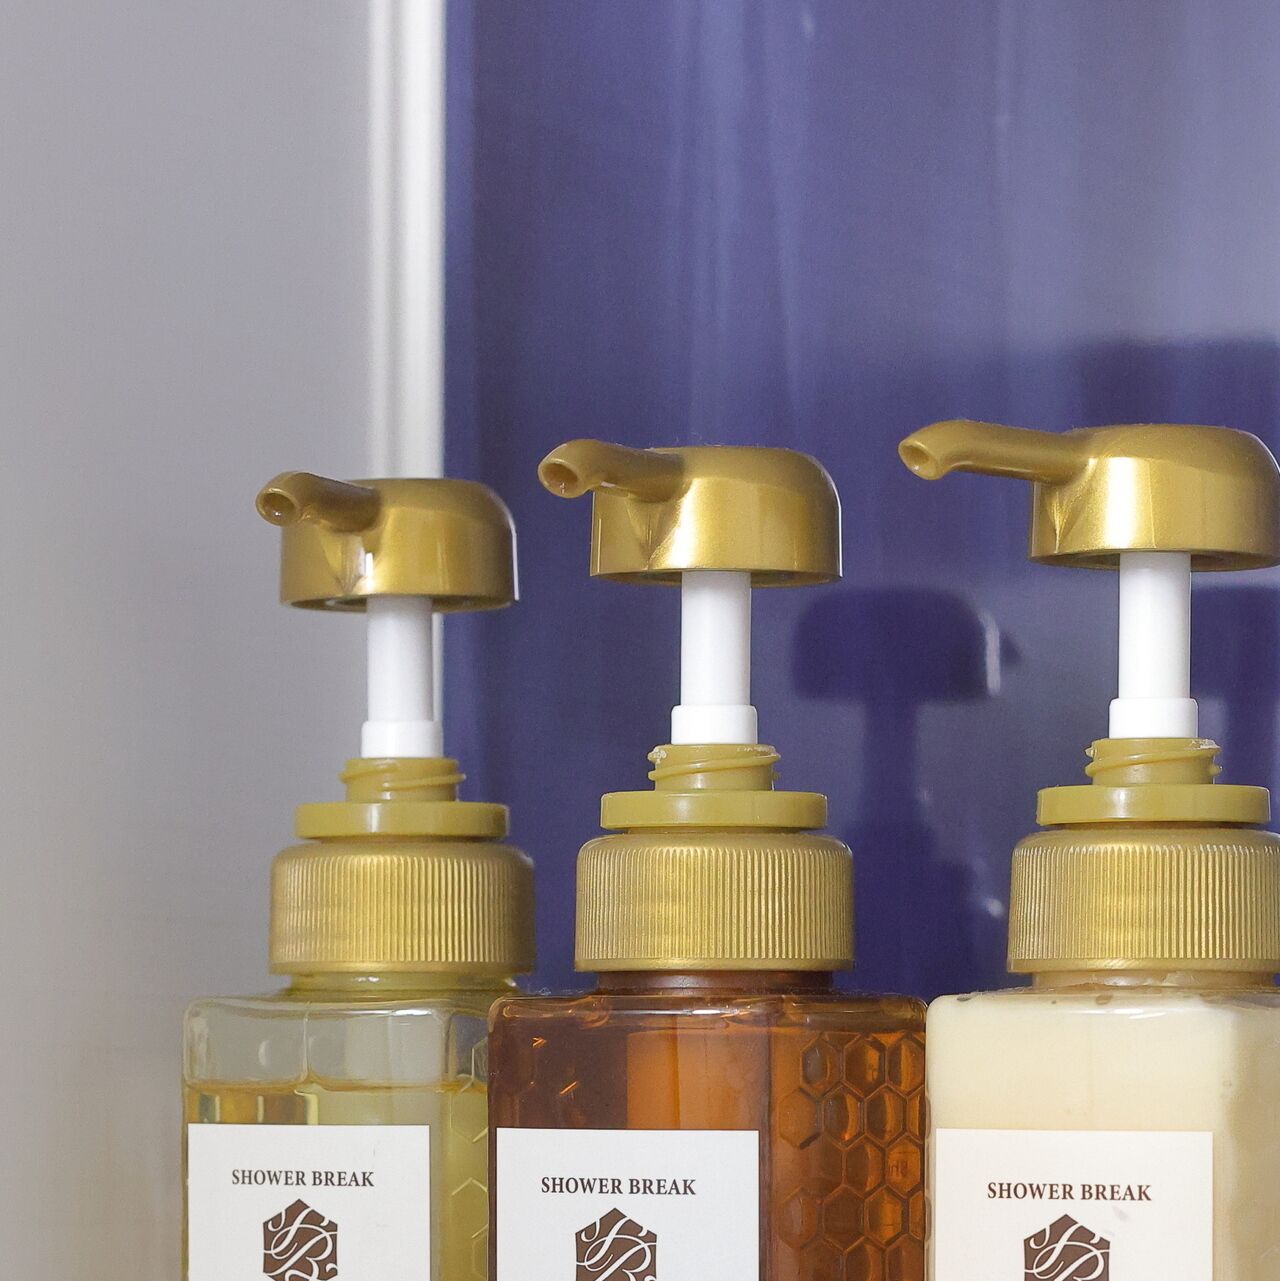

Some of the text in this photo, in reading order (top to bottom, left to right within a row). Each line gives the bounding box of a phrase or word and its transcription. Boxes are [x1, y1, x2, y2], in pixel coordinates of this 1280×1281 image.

[232, 1169, 374, 1187] SHOWER BREAK
[542, 1177, 696, 1195] SHOWER BREAK
[988, 1182, 1151, 1201] SHOWER BREAK
